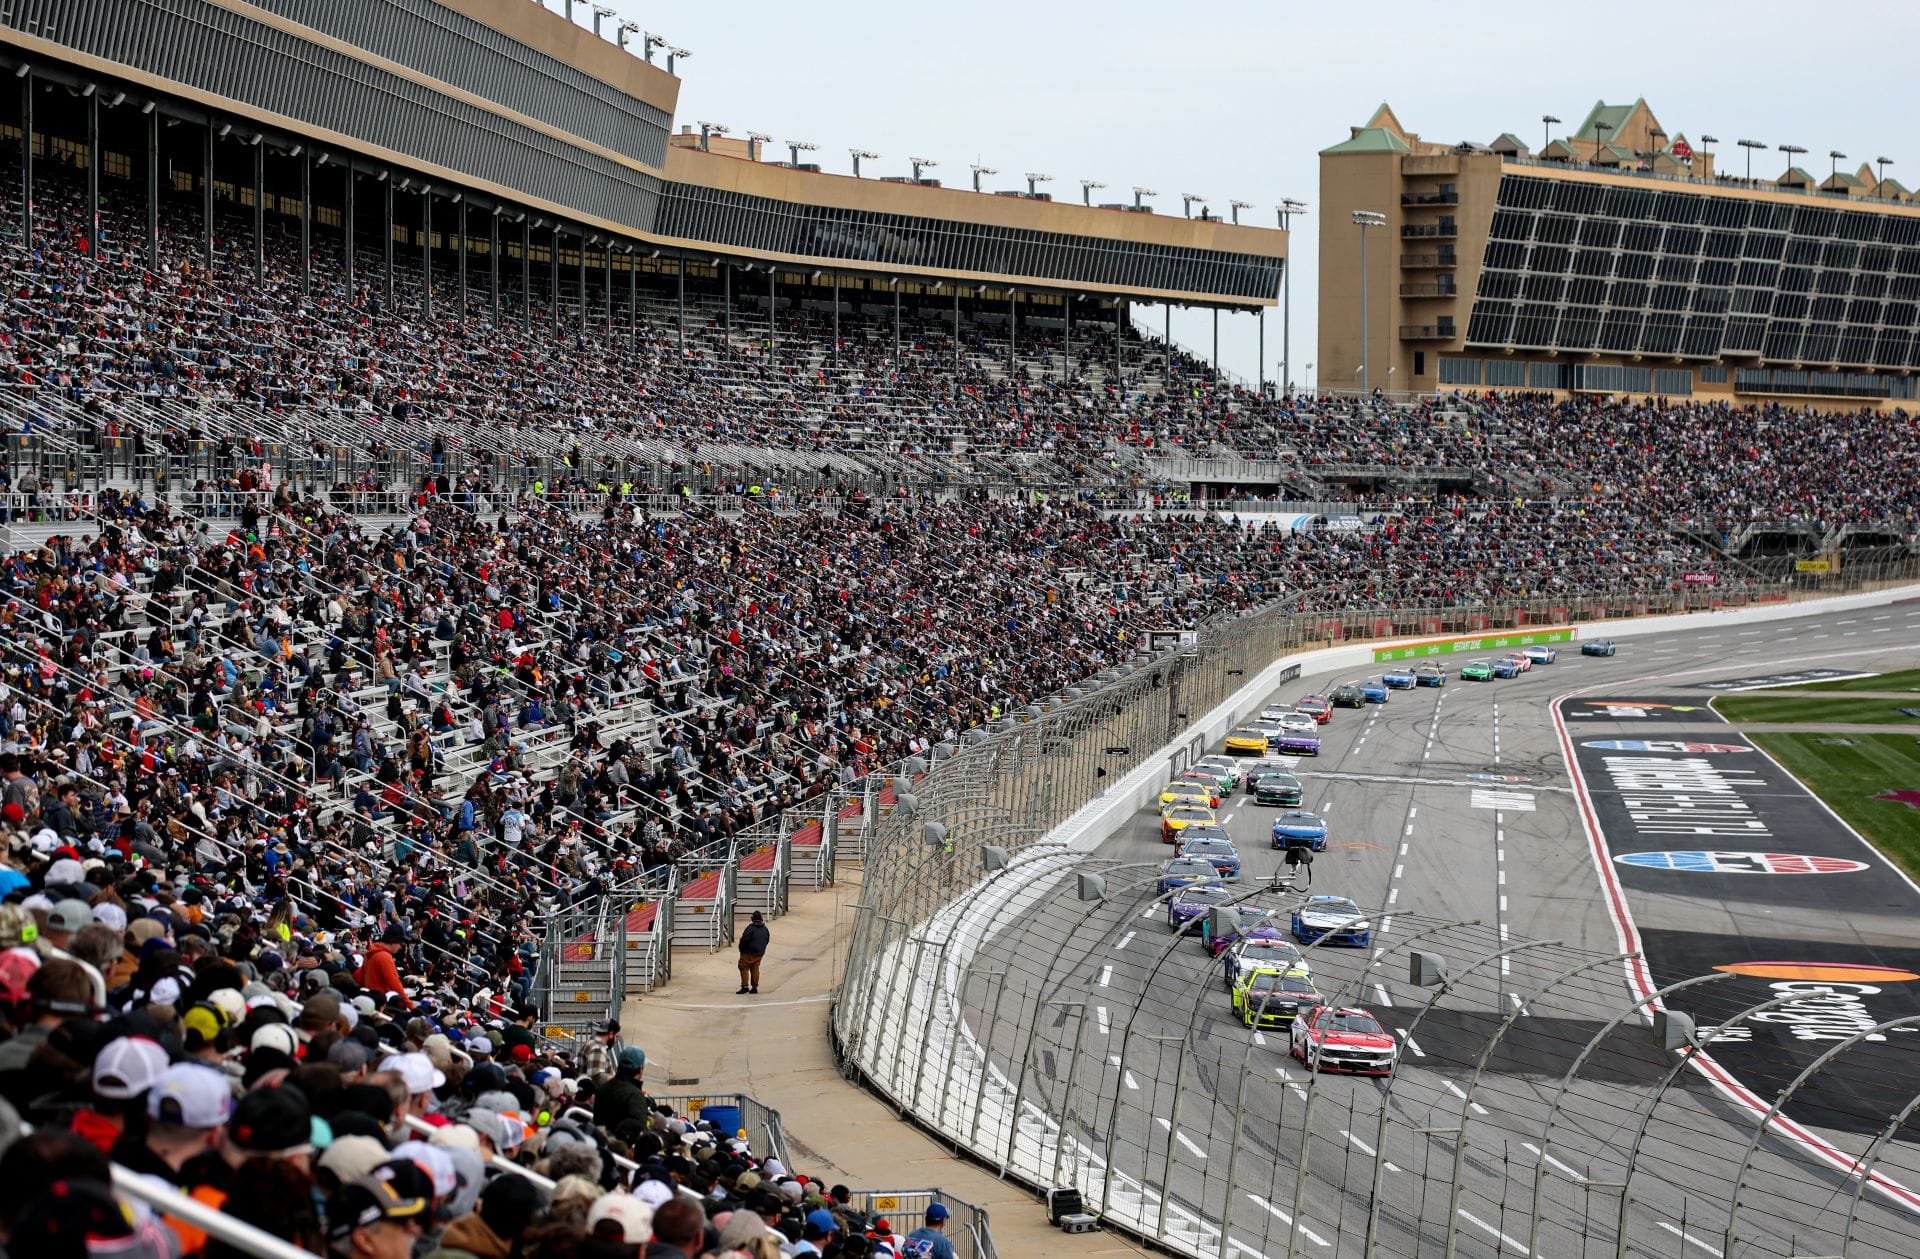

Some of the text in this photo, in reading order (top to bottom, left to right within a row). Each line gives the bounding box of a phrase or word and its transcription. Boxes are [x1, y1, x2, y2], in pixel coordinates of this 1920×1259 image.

[1685, 573, 1715, 583] ambetter
[1453, 639, 1481, 651] RESTART ZONE
[1601, 756, 1768, 794] ambetter
[1620, 793, 1774, 836] HEALTH
